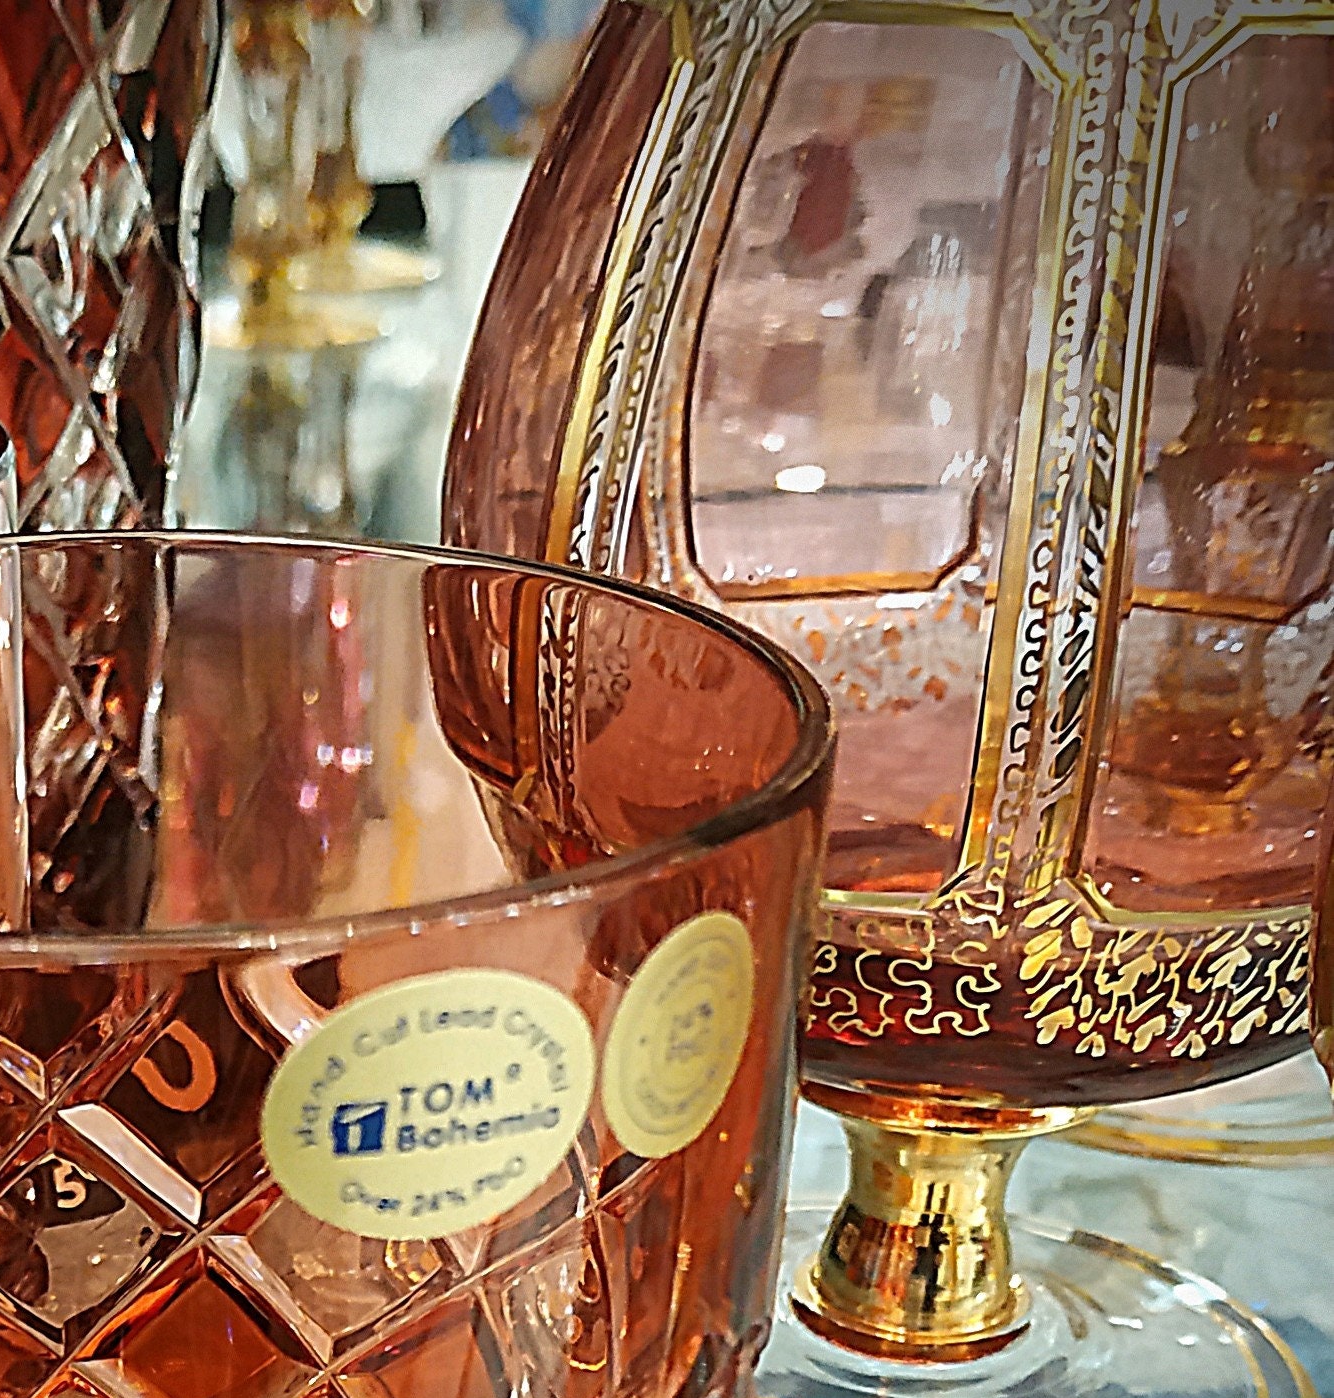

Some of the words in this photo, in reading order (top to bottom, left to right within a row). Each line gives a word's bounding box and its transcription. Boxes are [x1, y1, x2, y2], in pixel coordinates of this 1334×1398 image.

[504, 1007, 569, 1094] Crystal
[399, 1077, 494, 1114] TOM
[396, 1104, 561, 1153] Bohemia
